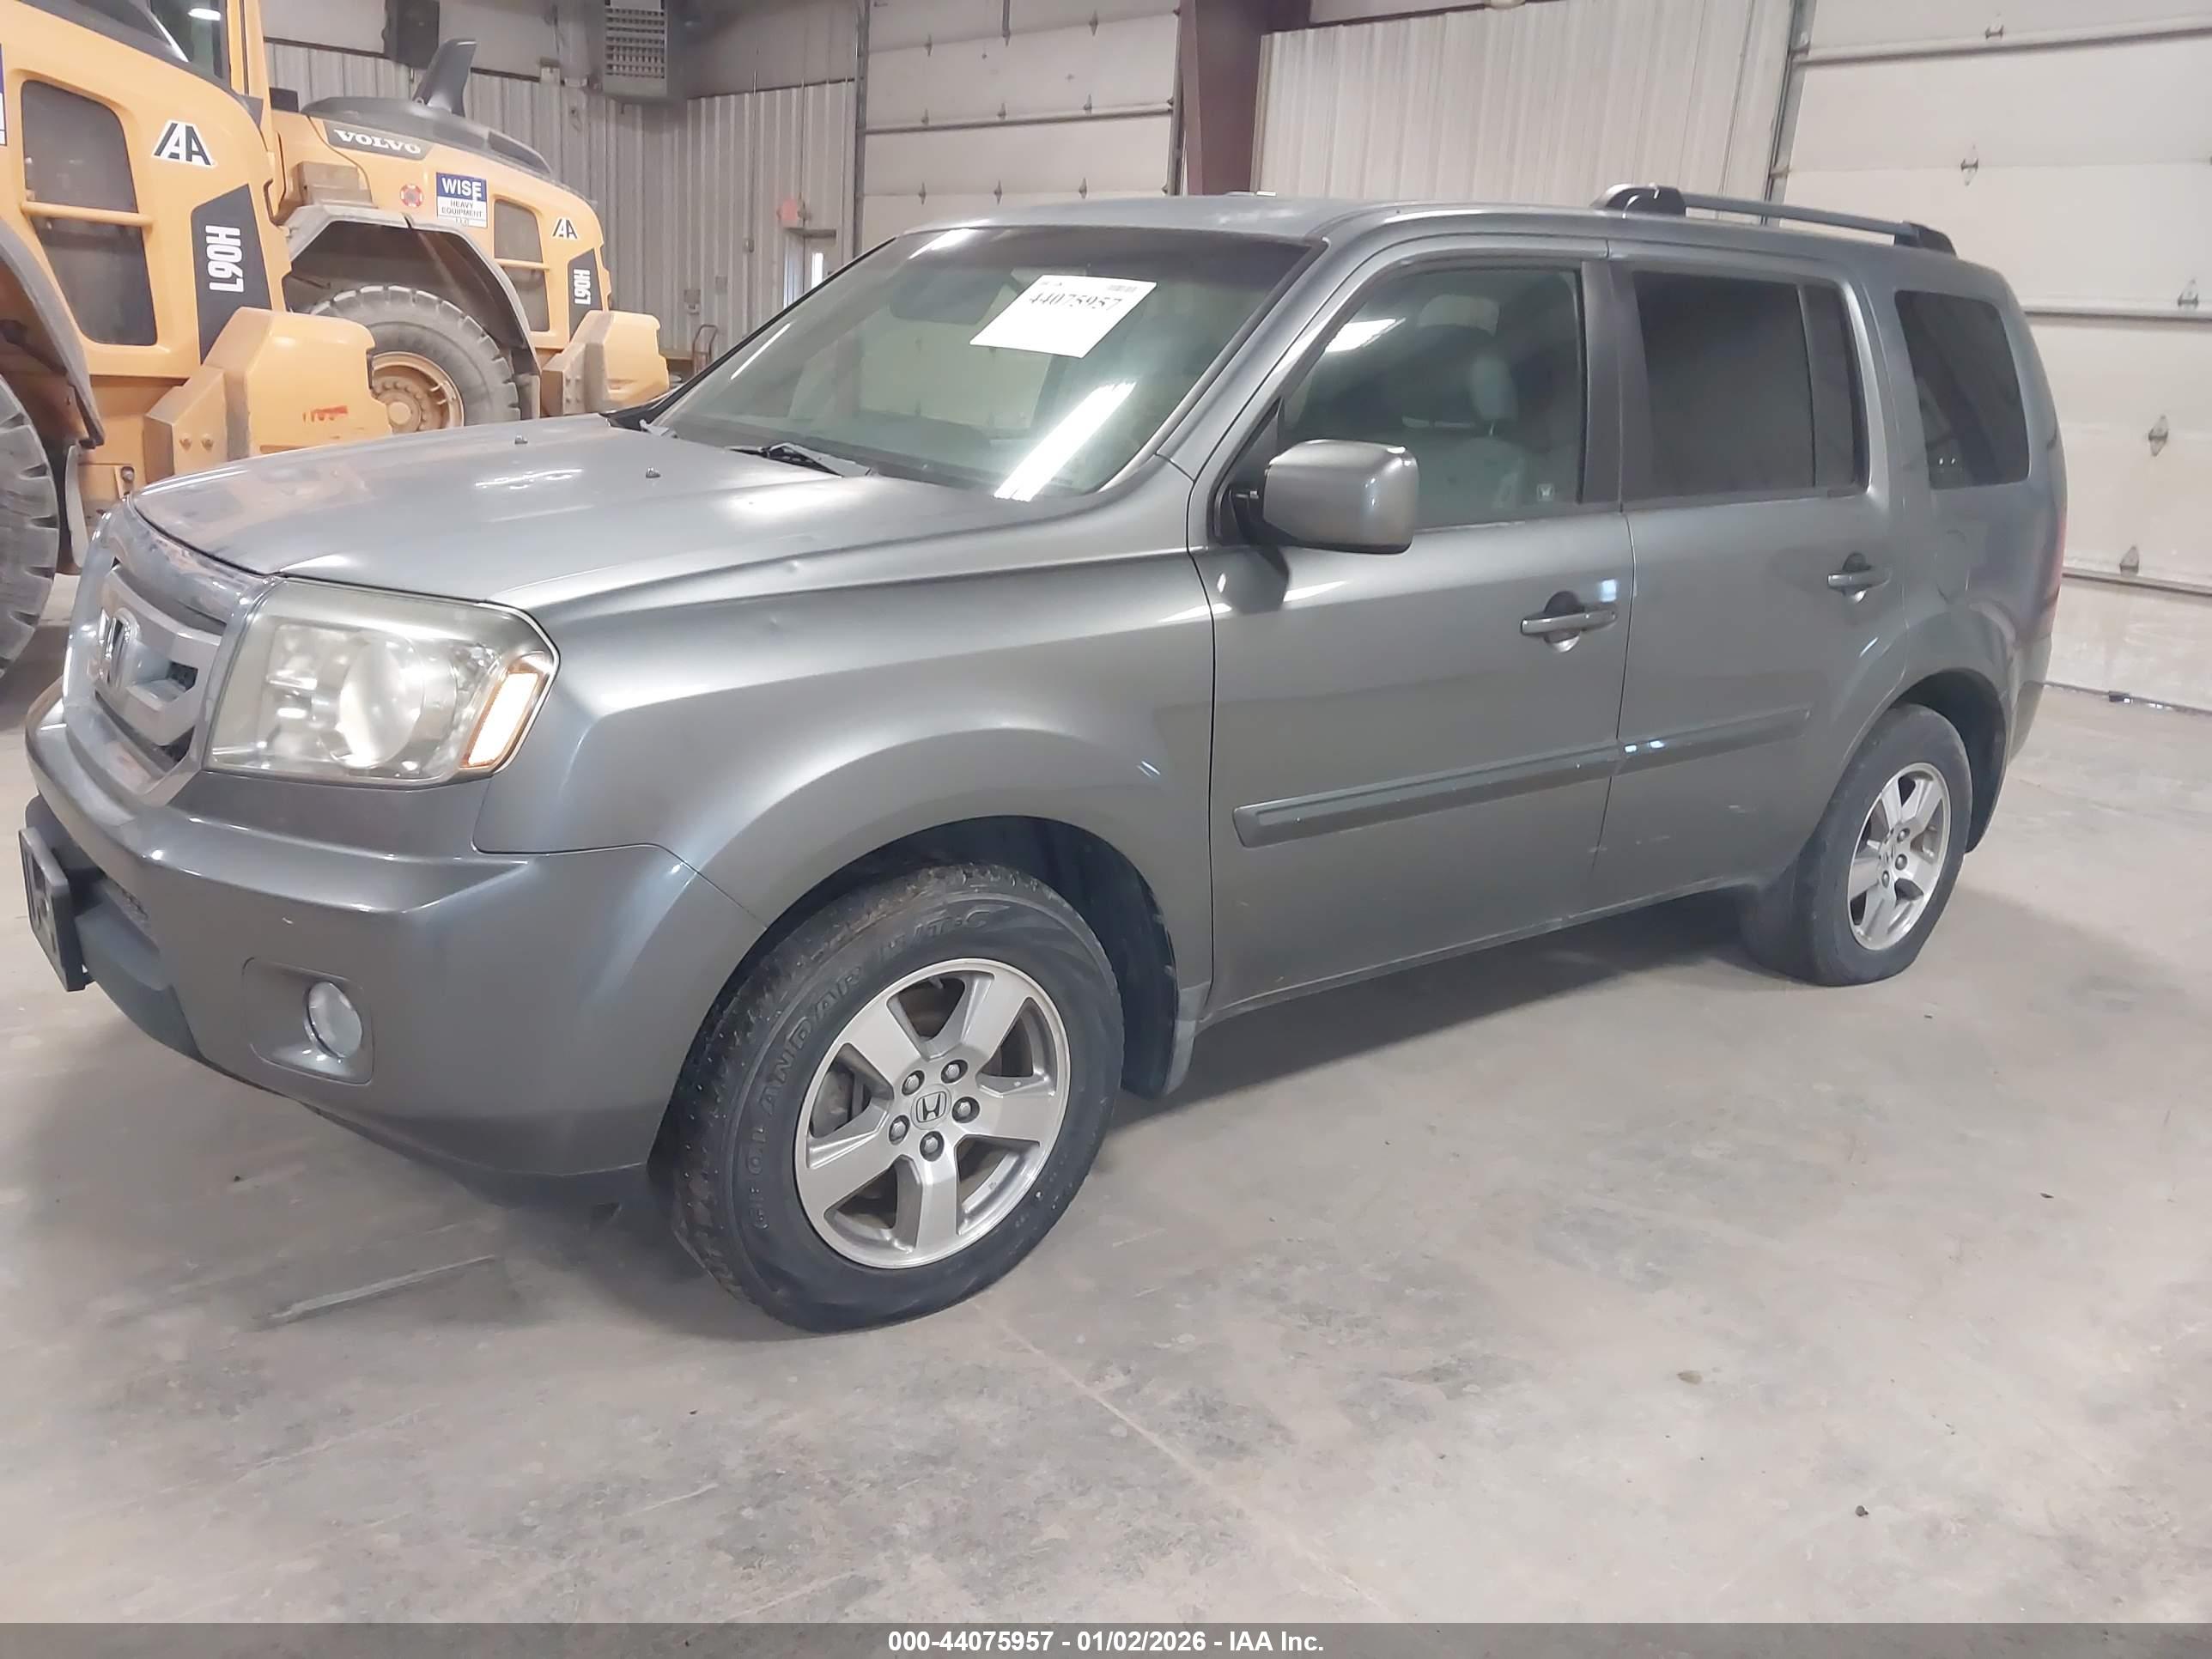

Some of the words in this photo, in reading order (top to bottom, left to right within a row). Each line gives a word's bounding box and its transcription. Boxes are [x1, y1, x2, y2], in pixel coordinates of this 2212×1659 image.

[333, 129, 422, 155] VOLVO
[441, 177, 483, 202] WISE
[441, 206, 483, 218] EQUIPMENT
[450, 198, 474, 209] HEAVY
[204, 224, 246, 293] L90H
[573, 268, 592, 306] L90H
[1030, 292, 1123, 312] 44075957
